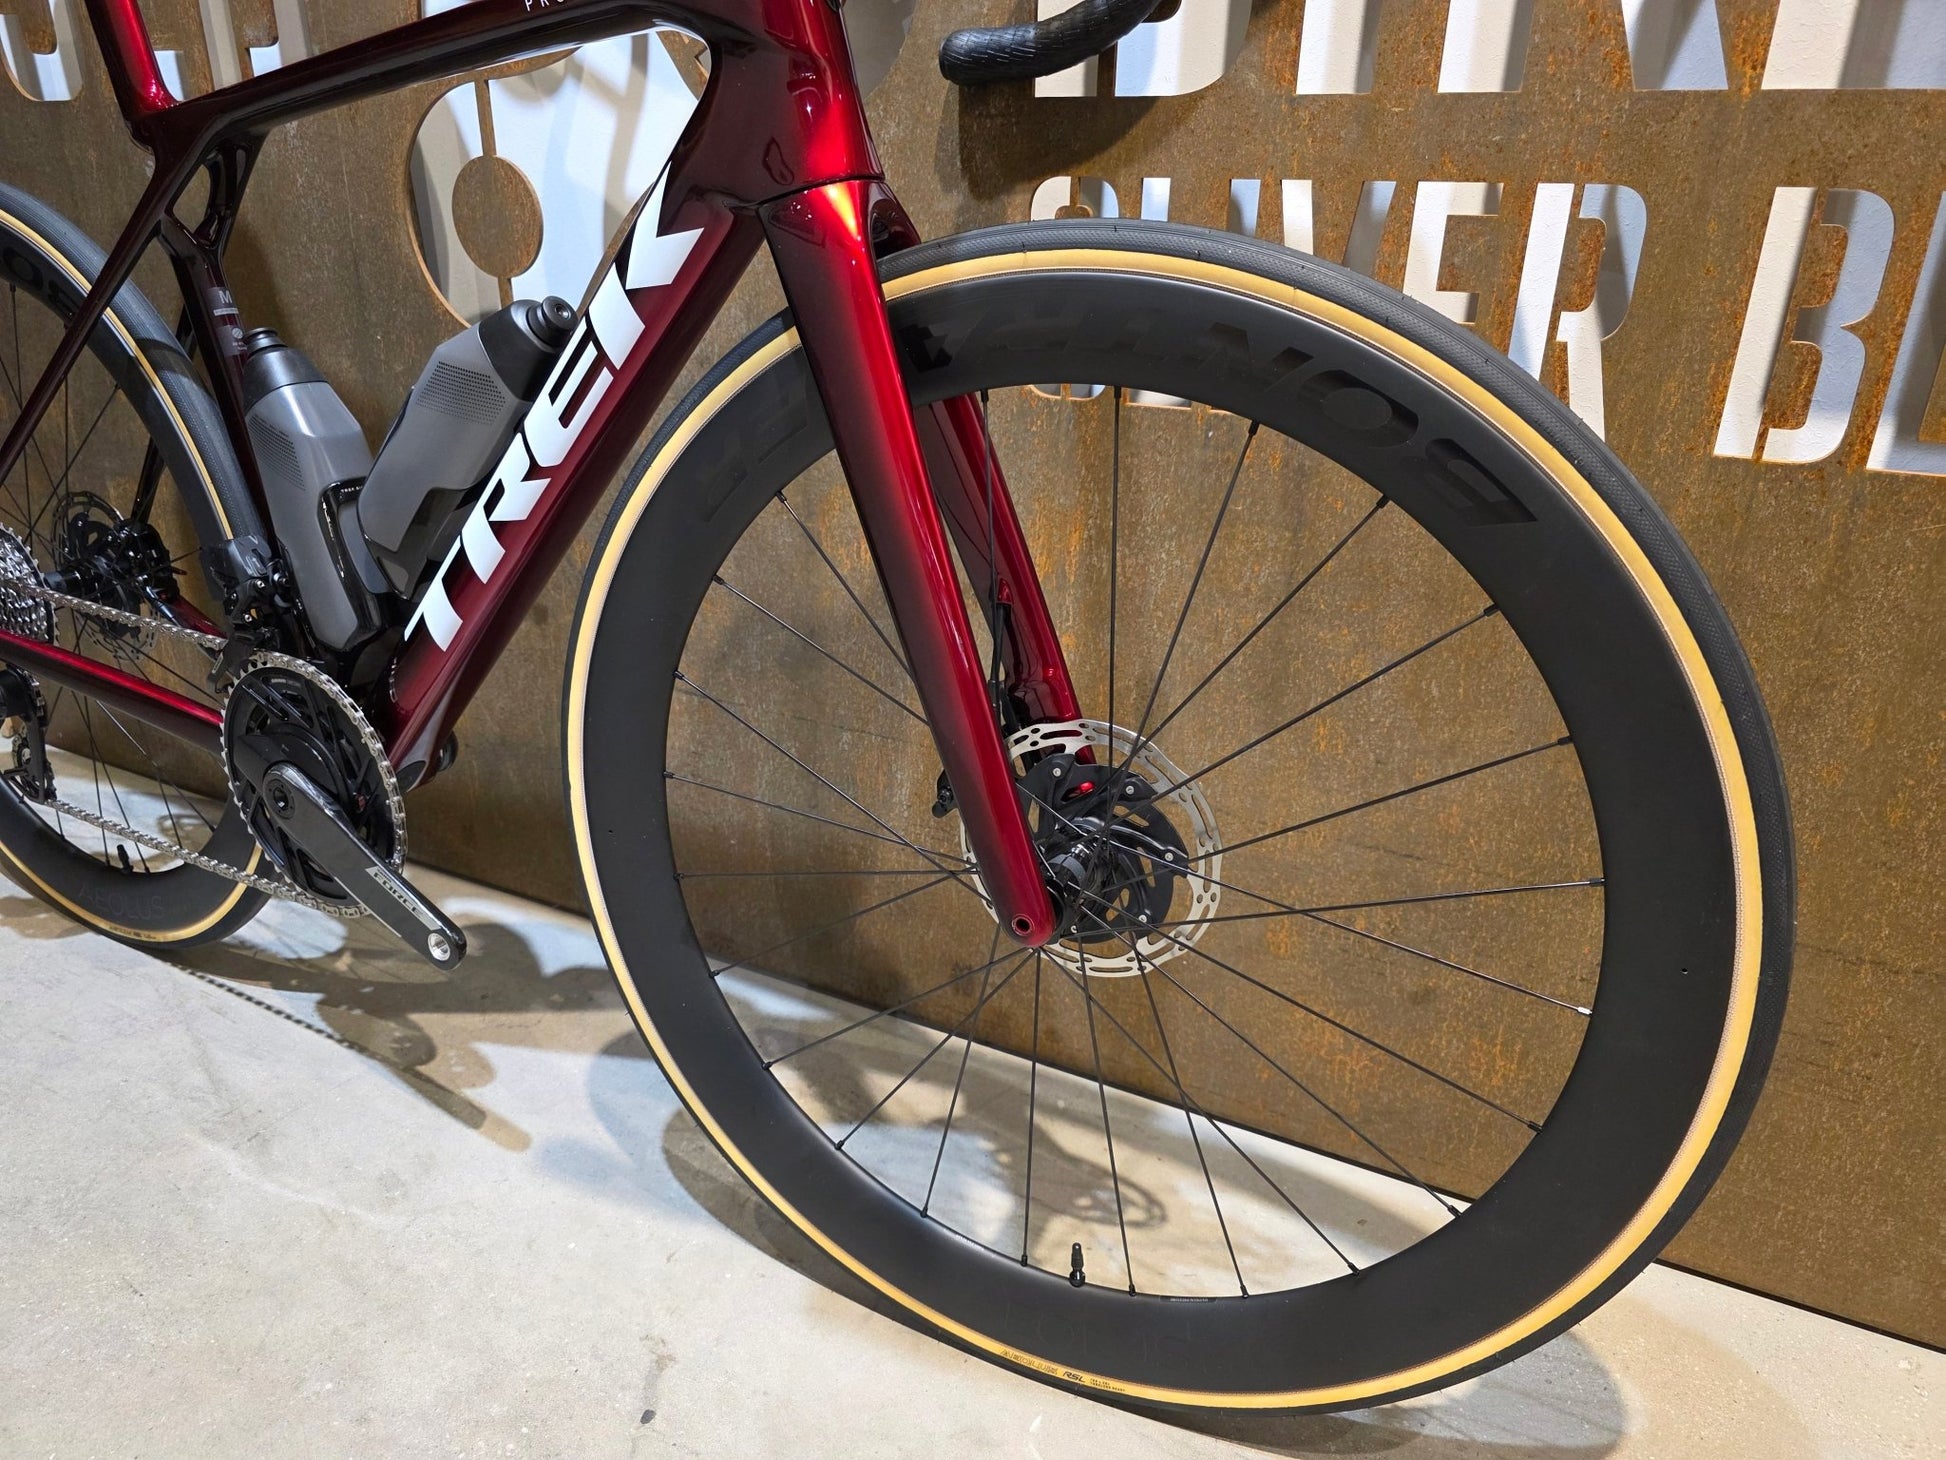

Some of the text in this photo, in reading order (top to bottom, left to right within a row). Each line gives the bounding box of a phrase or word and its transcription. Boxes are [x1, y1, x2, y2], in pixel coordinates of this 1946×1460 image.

[218, 290, 233, 304] M
[404, 161, 704, 651] TREK
[1062, 1371, 1086, 1383] RSL
